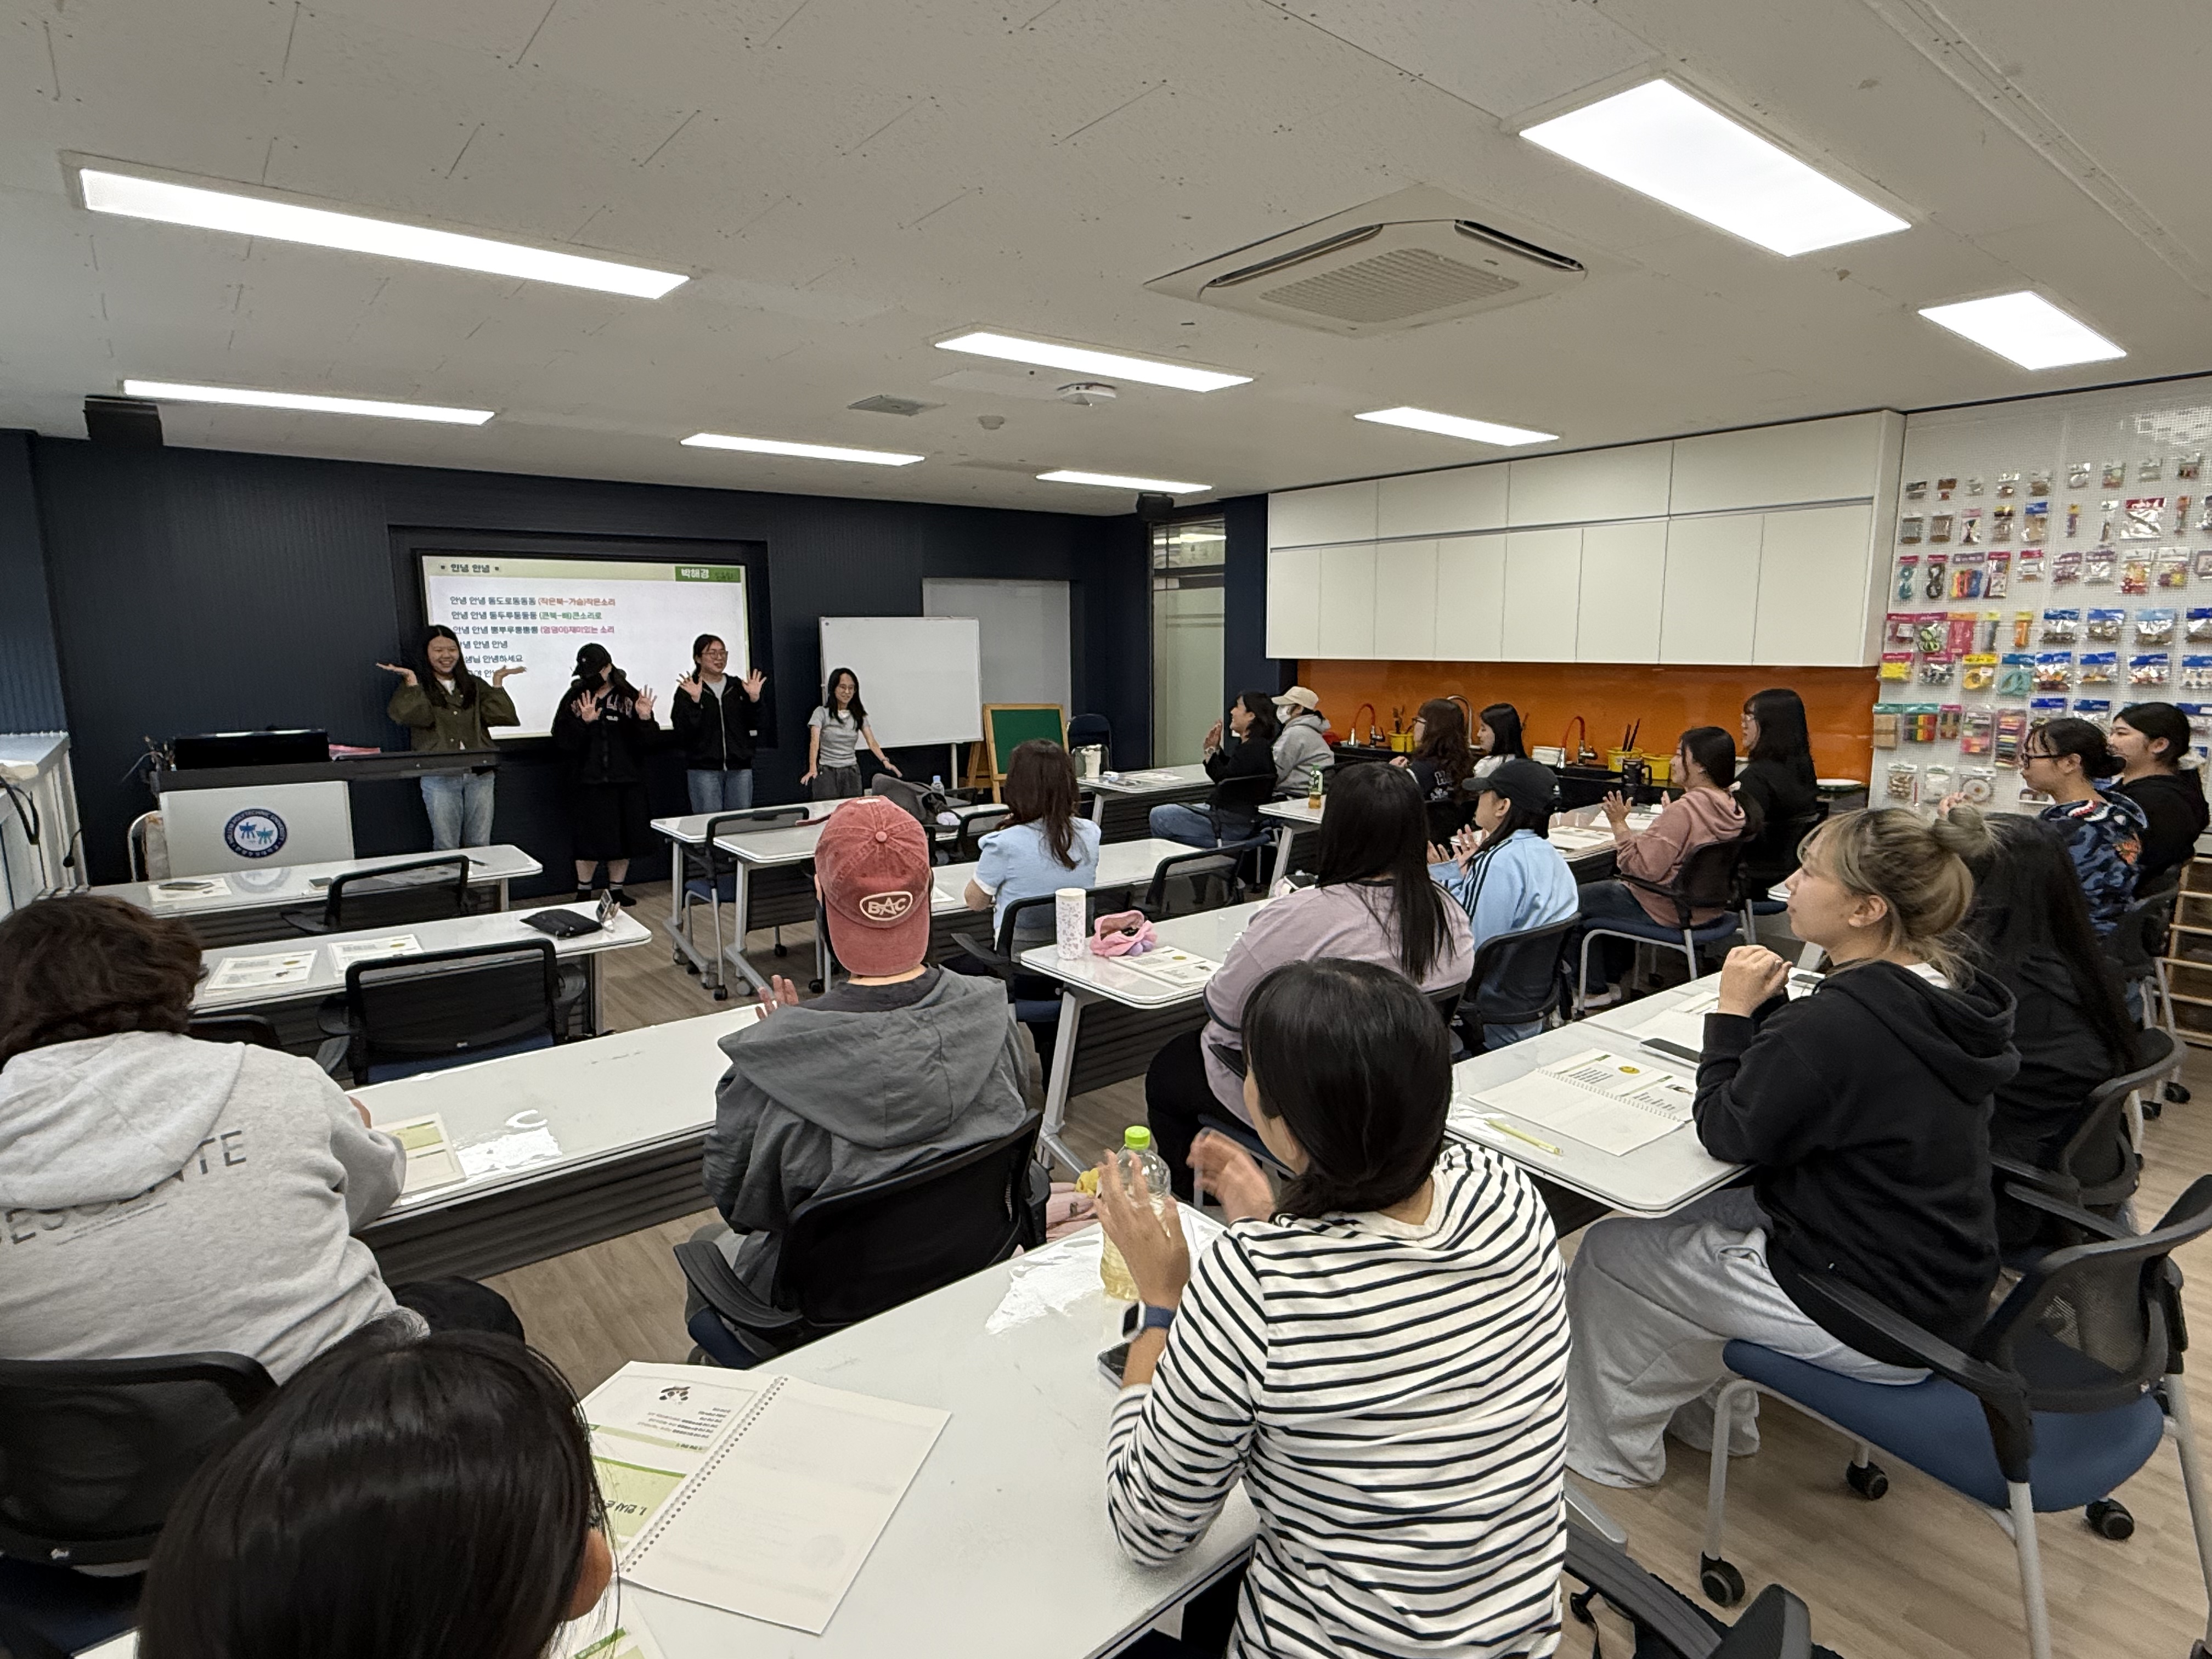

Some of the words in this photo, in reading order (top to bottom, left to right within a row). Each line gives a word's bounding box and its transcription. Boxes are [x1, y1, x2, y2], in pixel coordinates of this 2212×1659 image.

[472, 564, 490, 573] 안녕
[681, 568, 709, 579] 박해경
[450, 596, 467, 605] 안녕
[469, 596, 486, 605] 안녕
[451, 611, 468, 619] 안녕
[470, 611, 487, 619] 안녕
[453, 626, 469, 634] 안녕
[472, 626, 488, 634] 안녕
[473, 641, 489, 649] 안녕
[492, 640, 507, 648] 안녕
[465, 655, 481, 663] 생님
[482, 654, 523, 663] 안녕하세요
